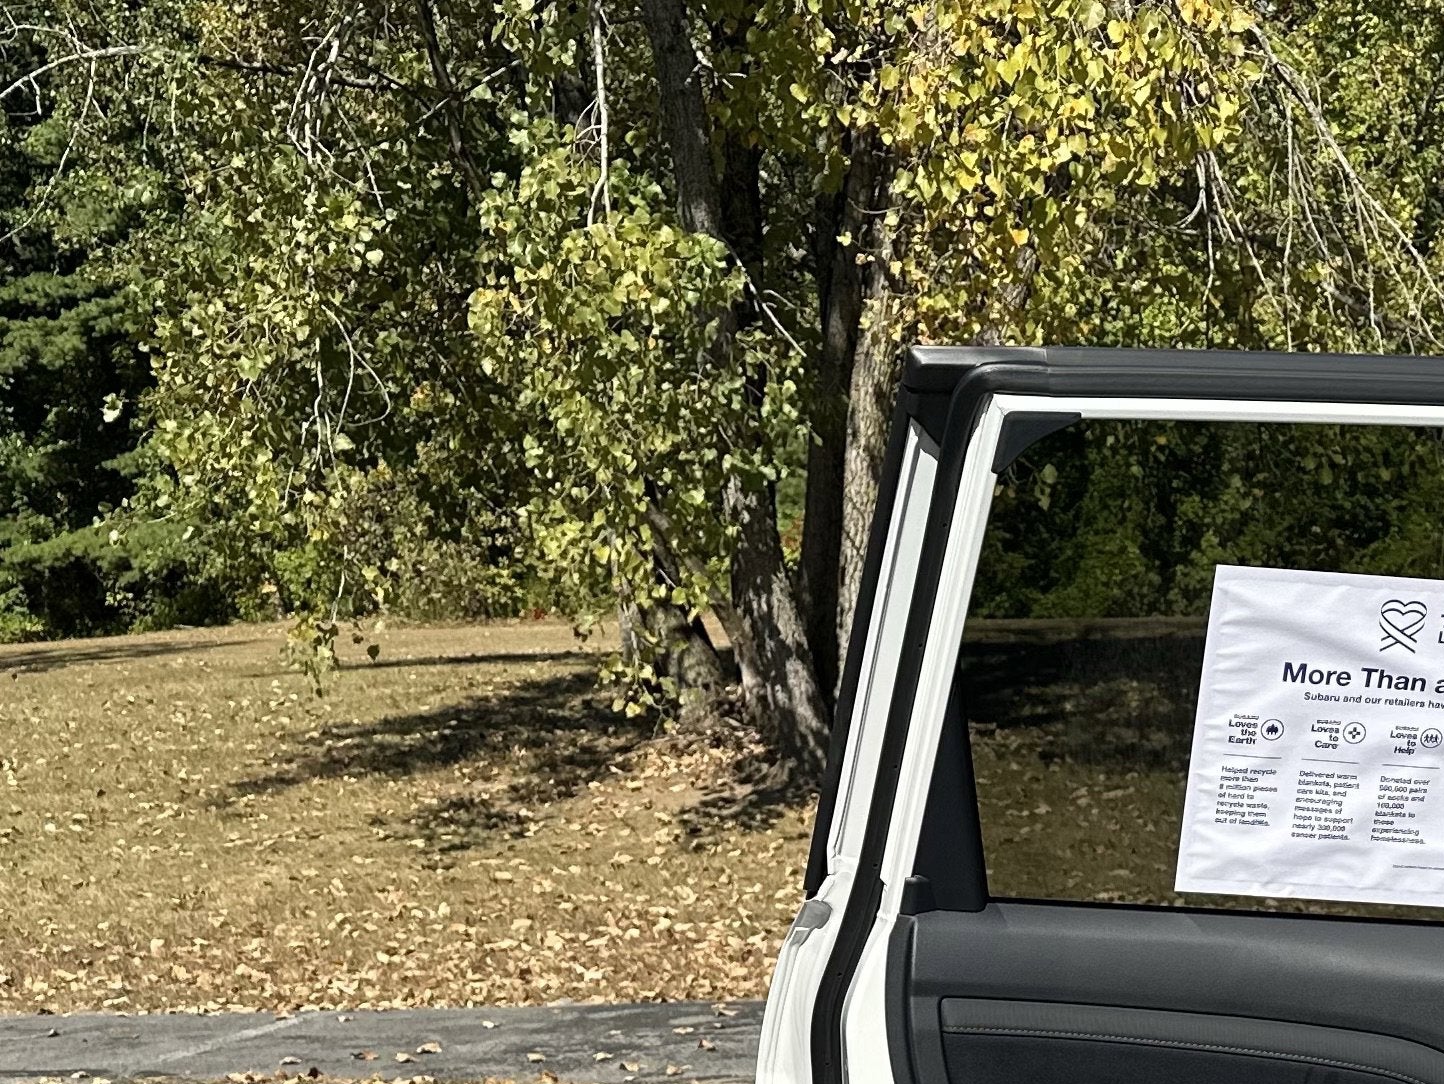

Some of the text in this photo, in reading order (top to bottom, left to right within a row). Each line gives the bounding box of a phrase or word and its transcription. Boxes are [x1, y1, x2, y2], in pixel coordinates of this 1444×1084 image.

[1282, 662, 1351, 686] More
[1361, 667, 1426, 691] Than
[1304, 691, 1340, 701] Subaru
[1342, 694, 1362, 703] and
[1384, 697, 1425, 707] retailers
[1228, 719, 1257, 728] Loves
[1228, 735, 1256, 744] Earth
[1328, 733, 1338, 741] to
[1406, 739, 1416, 747] to
